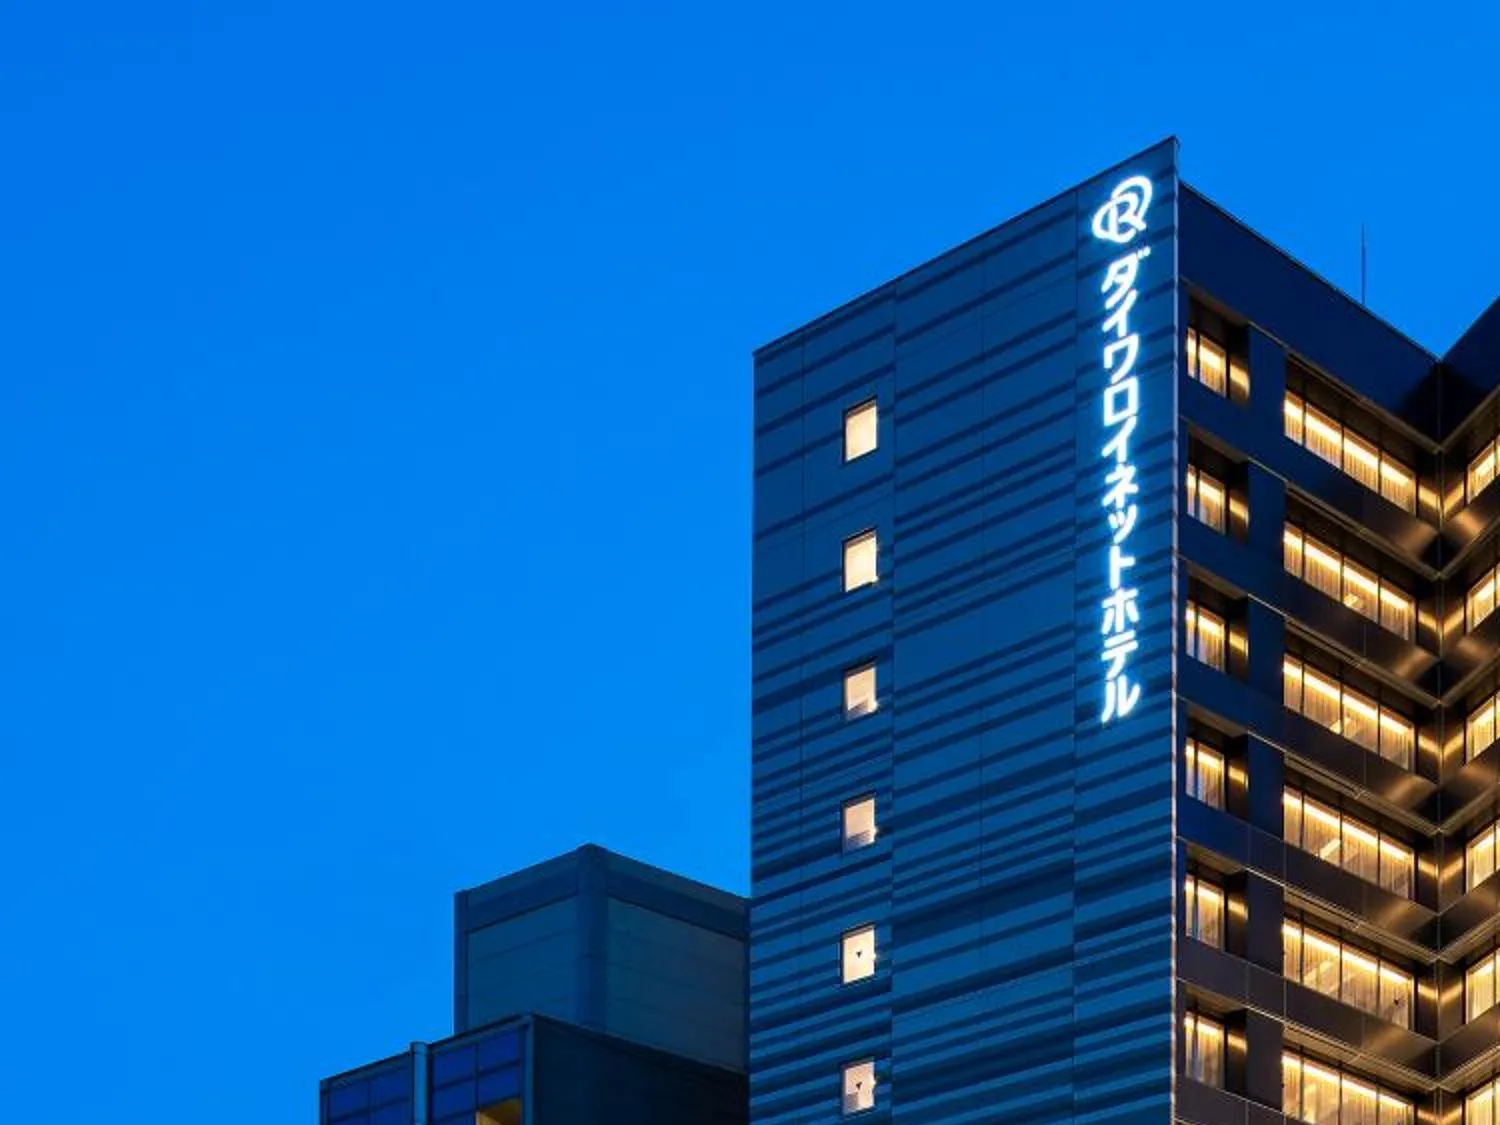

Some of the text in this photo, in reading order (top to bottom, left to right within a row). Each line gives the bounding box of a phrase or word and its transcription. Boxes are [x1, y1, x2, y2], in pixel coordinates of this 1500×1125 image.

[1100, 246, 1150, 723] ダイワロイネットホテル
